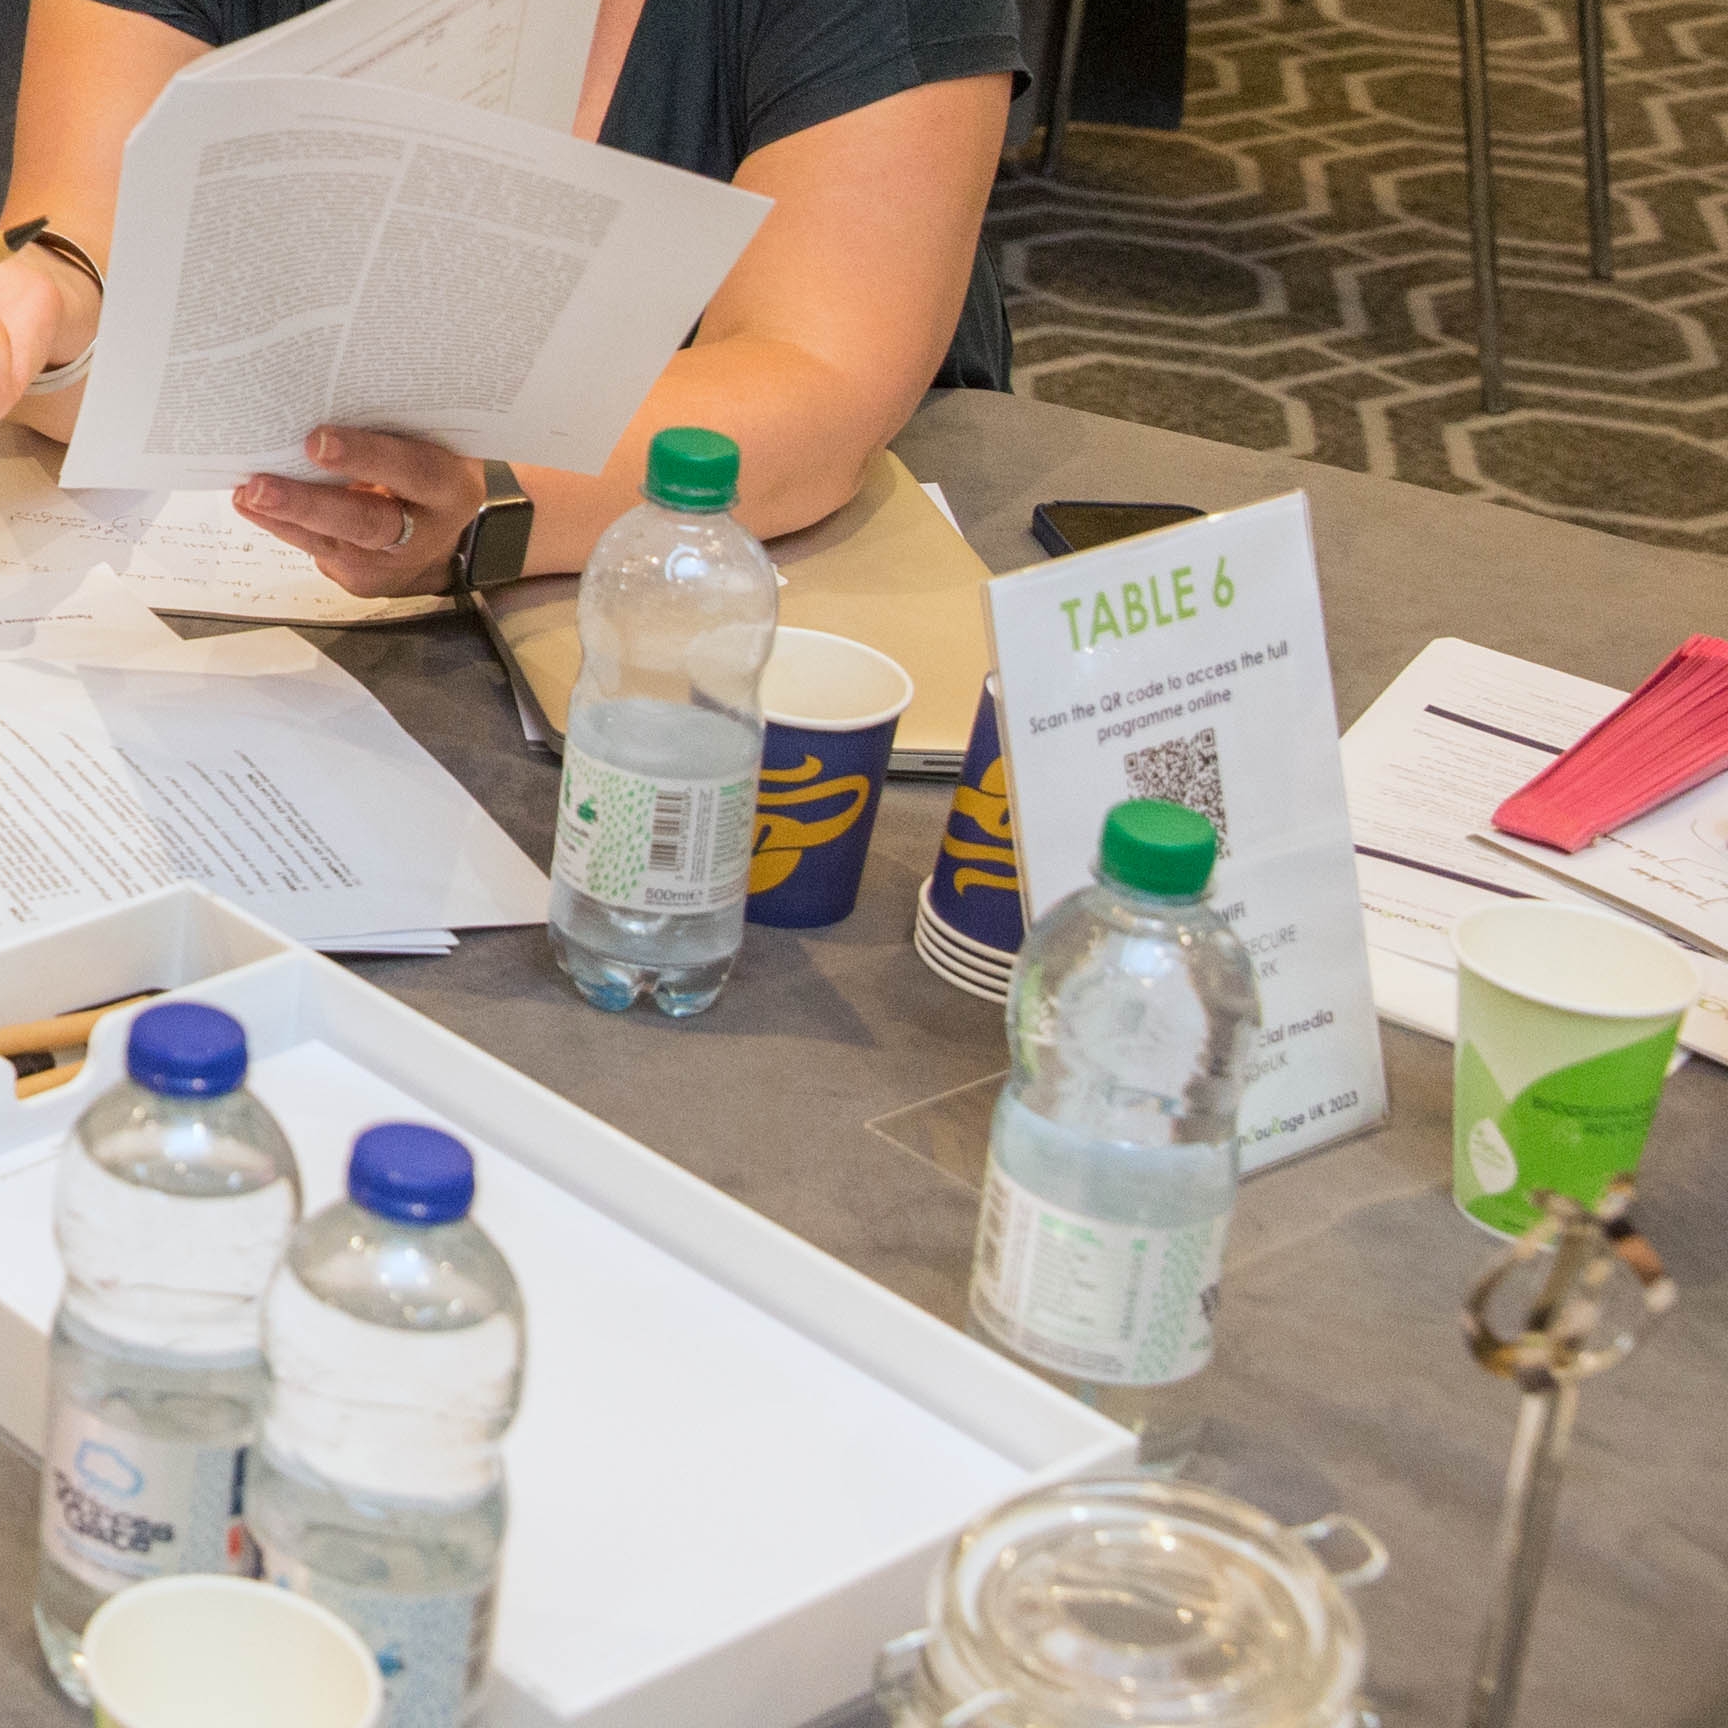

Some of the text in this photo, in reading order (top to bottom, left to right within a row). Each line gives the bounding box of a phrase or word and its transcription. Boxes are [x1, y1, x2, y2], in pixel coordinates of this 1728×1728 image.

[1060, 553, 1236, 655] TABLE 6
[1028, 639, 1288, 736] Scan the QR code to access the full
[1096, 685, 1231, 745] programme online
[1248, 924, 1297, 956] ECURE
[1288, 1009, 1334, 1037] media
[1238, 1090, 1359, 1147] nCouRage UK 2023
